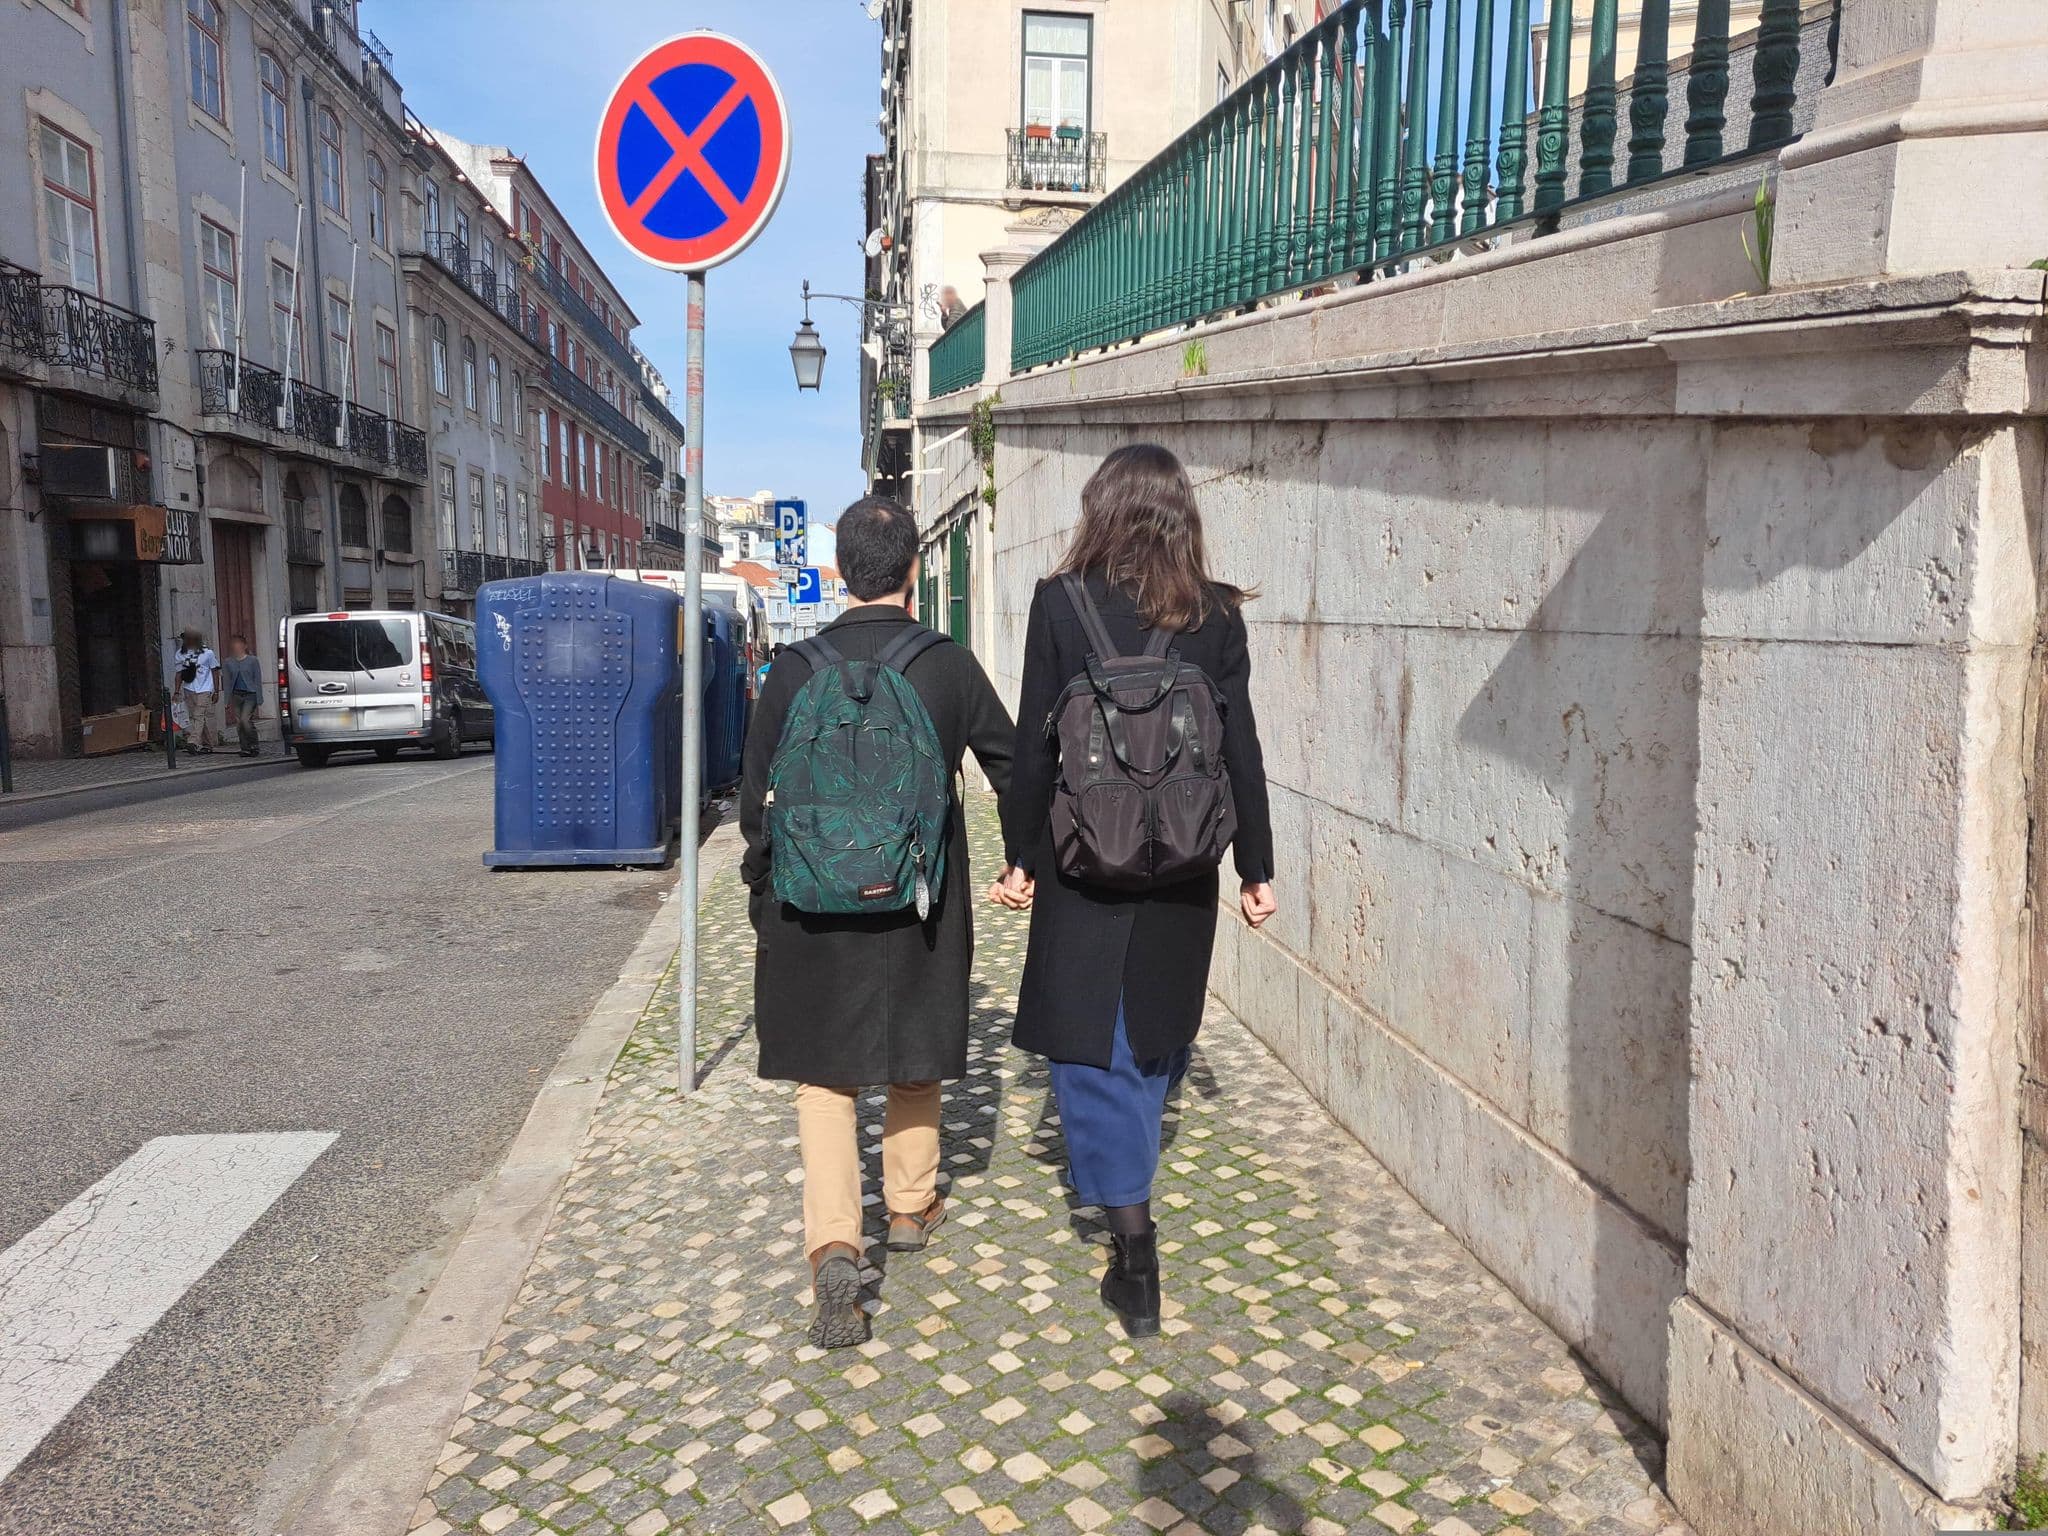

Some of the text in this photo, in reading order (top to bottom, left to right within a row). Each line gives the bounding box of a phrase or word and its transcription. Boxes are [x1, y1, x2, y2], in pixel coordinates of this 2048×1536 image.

[165, 510, 189, 536] CLUB
[166, 535, 192, 560] NOIR
[795, 572, 813, 600] P
[863, 886, 894, 896] EASTPAK
